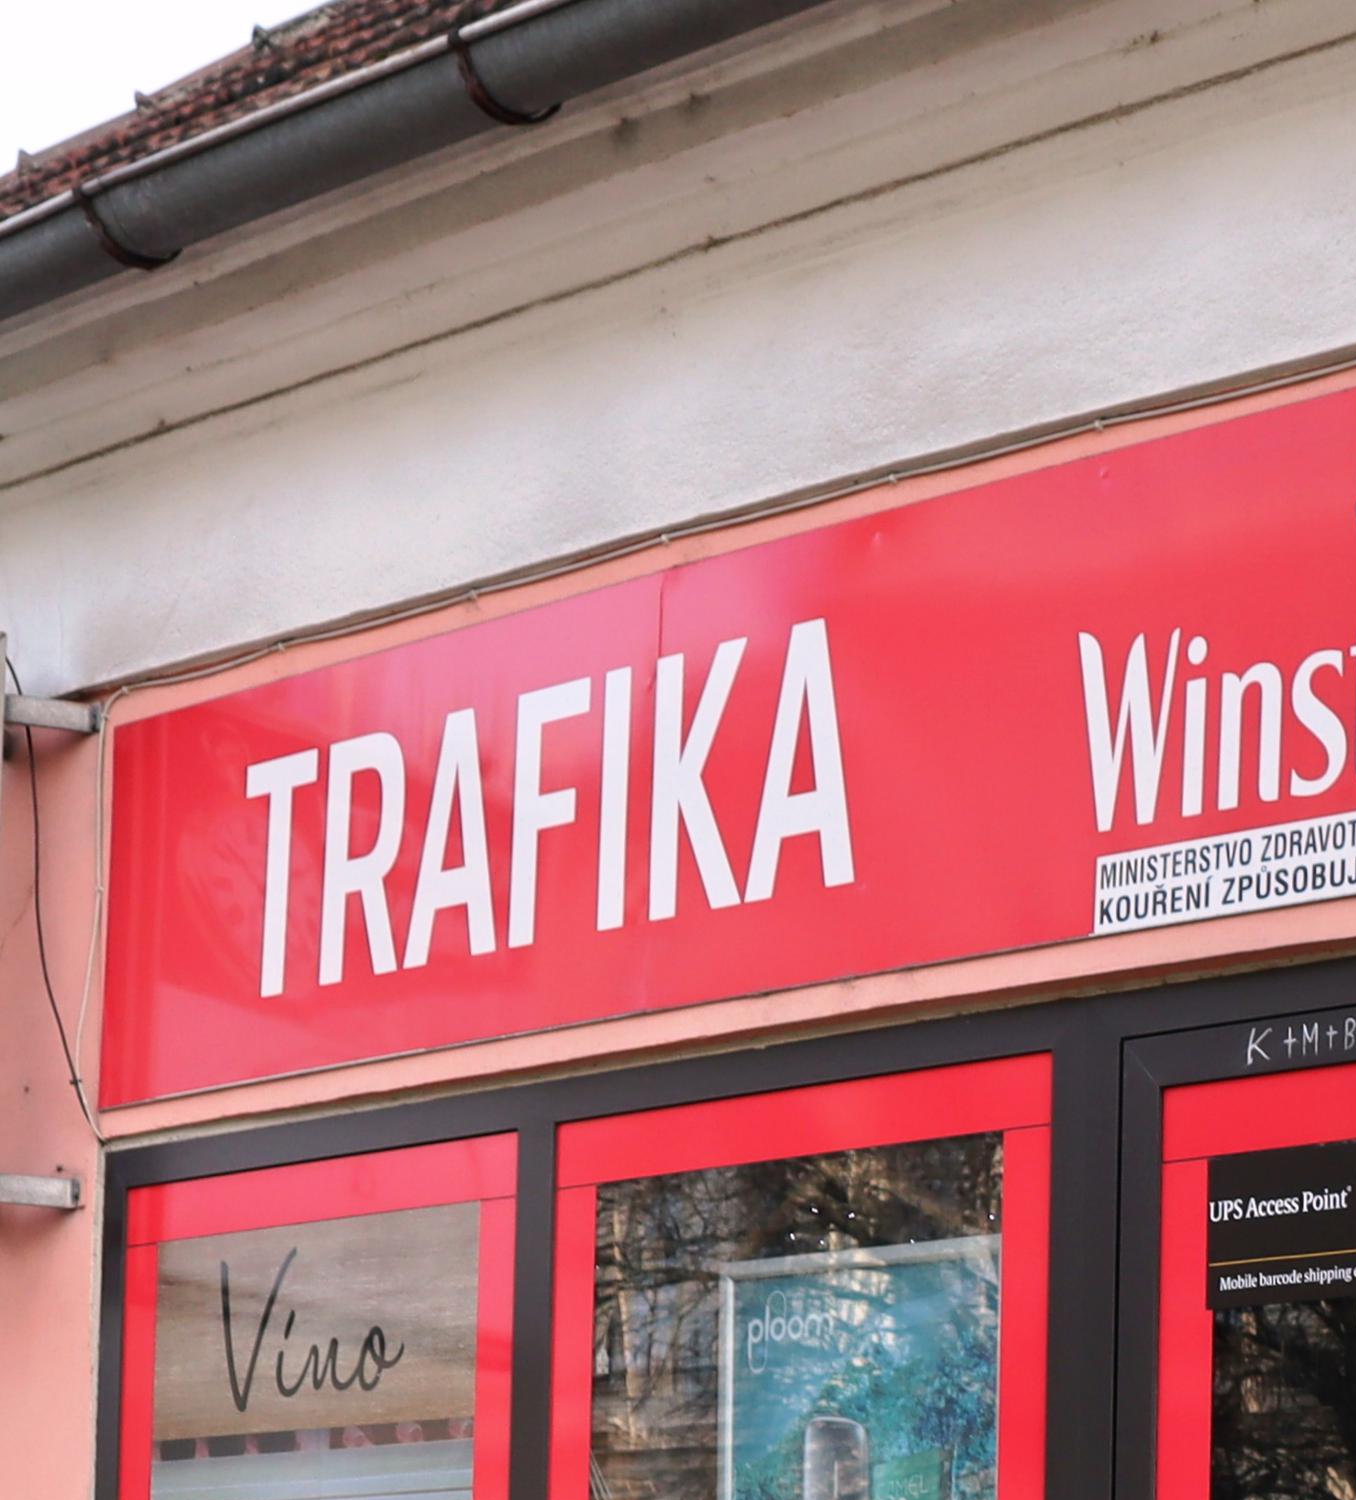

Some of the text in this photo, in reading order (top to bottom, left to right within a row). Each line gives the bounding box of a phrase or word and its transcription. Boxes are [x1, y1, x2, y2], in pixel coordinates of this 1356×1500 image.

[246, 618, 855, 998] TRAFIKA
[1100, 836, 1253, 890] MINISTERSTVO
[1099, 876, 1213, 925] KOUŘENÍ
[1209, 1199, 1243, 1223] UPS
[1246, 1192, 1300, 1219] Access
[1219, 1269, 1258, 1292] Mobile
[1259, 1266, 1303, 1287] barcode
[1304, 1263, 1353, 1284] shipping
[220, 1246, 405, 1413] Víno
